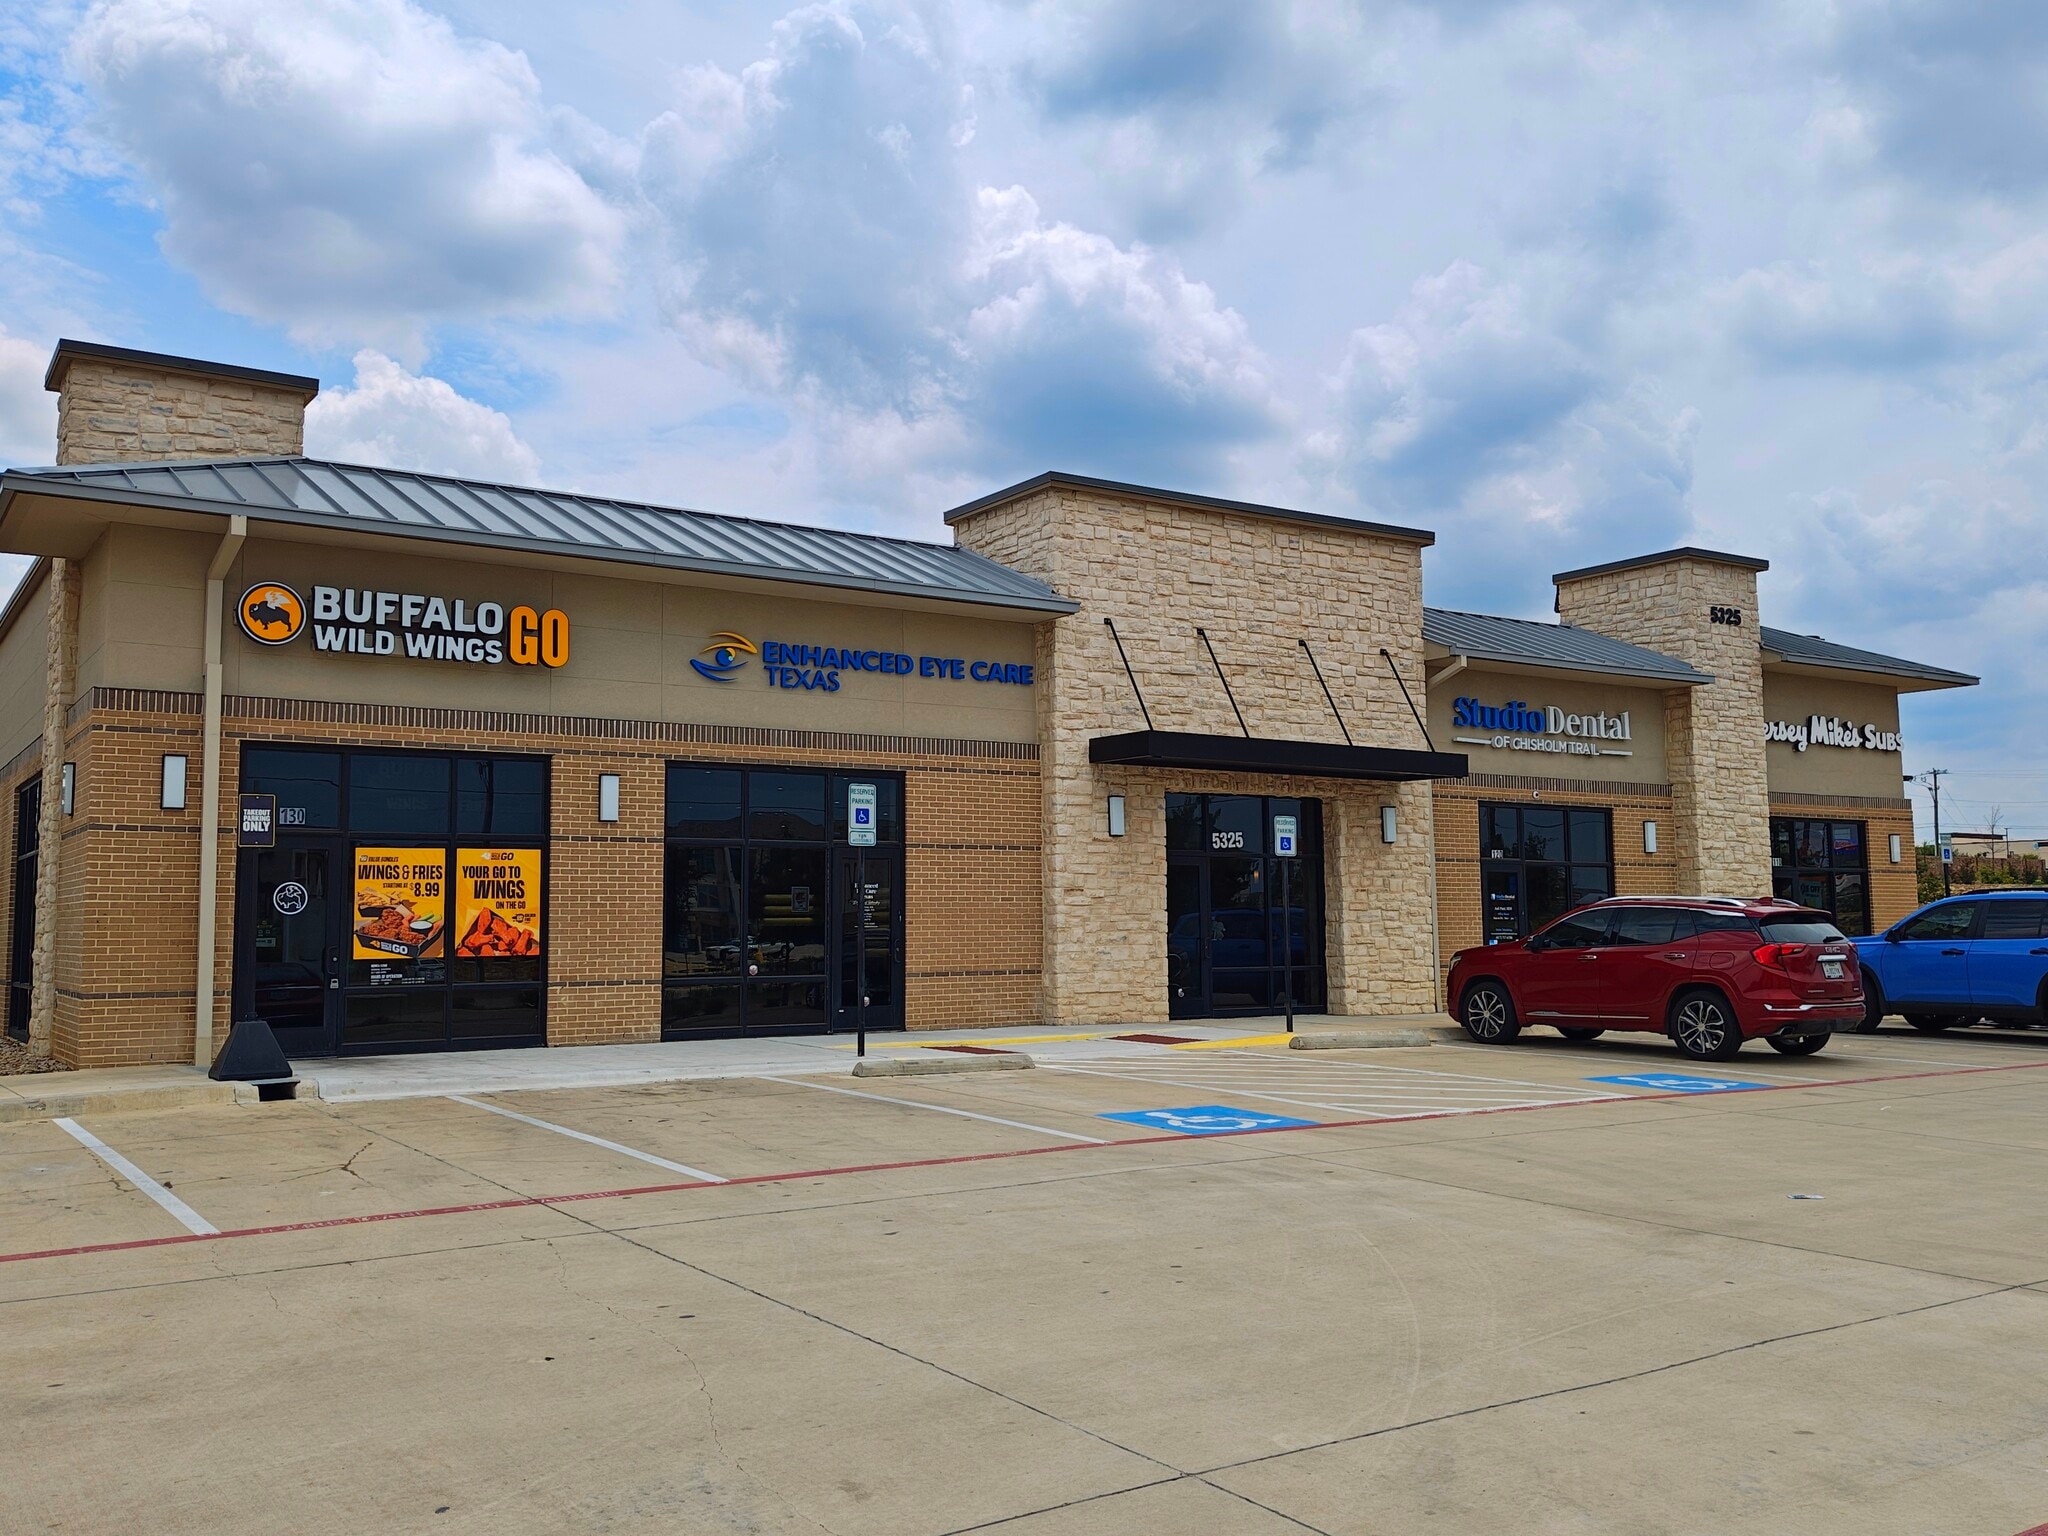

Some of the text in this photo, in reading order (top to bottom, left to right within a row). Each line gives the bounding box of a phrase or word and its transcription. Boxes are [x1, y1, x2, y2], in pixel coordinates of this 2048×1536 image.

[312, 586, 503, 635] BUFFALO
[1710, 606, 1742, 626] 5325
[313, 624, 503, 664] WILD WINGS
[509, 605, 571, 668] GO
[762, 641, 1034, 685] ENHANCED EYE CARE
[763, 665, 840, 692] TEXAS
[1763, 721, 1808, 752] ersey
[1809, 715, 1863, 748] Mike's
[1493, 736, 1600, 756] OF CHISHOLM TRAIL
[851, 788, 874, 796] RESERVED
[852, 797, 873, 805] PARKING
[243, 808, 271, 816] TAKEOUT
[280, 808, 305, 824] 130
[242, 821, 271, 832] ONLY
[1212, 832, 1244, 849] 5325
[500, 852, 514, 861] GO
[358, 864, 443, 880] WINGS & FRIES
[462, 866, 521, 879] YOUR GO TO
[473, 880, 525, 899] WINGS
[495, 901, 526, 910] ON THE GO
[392, 944, 408, 955] GO
